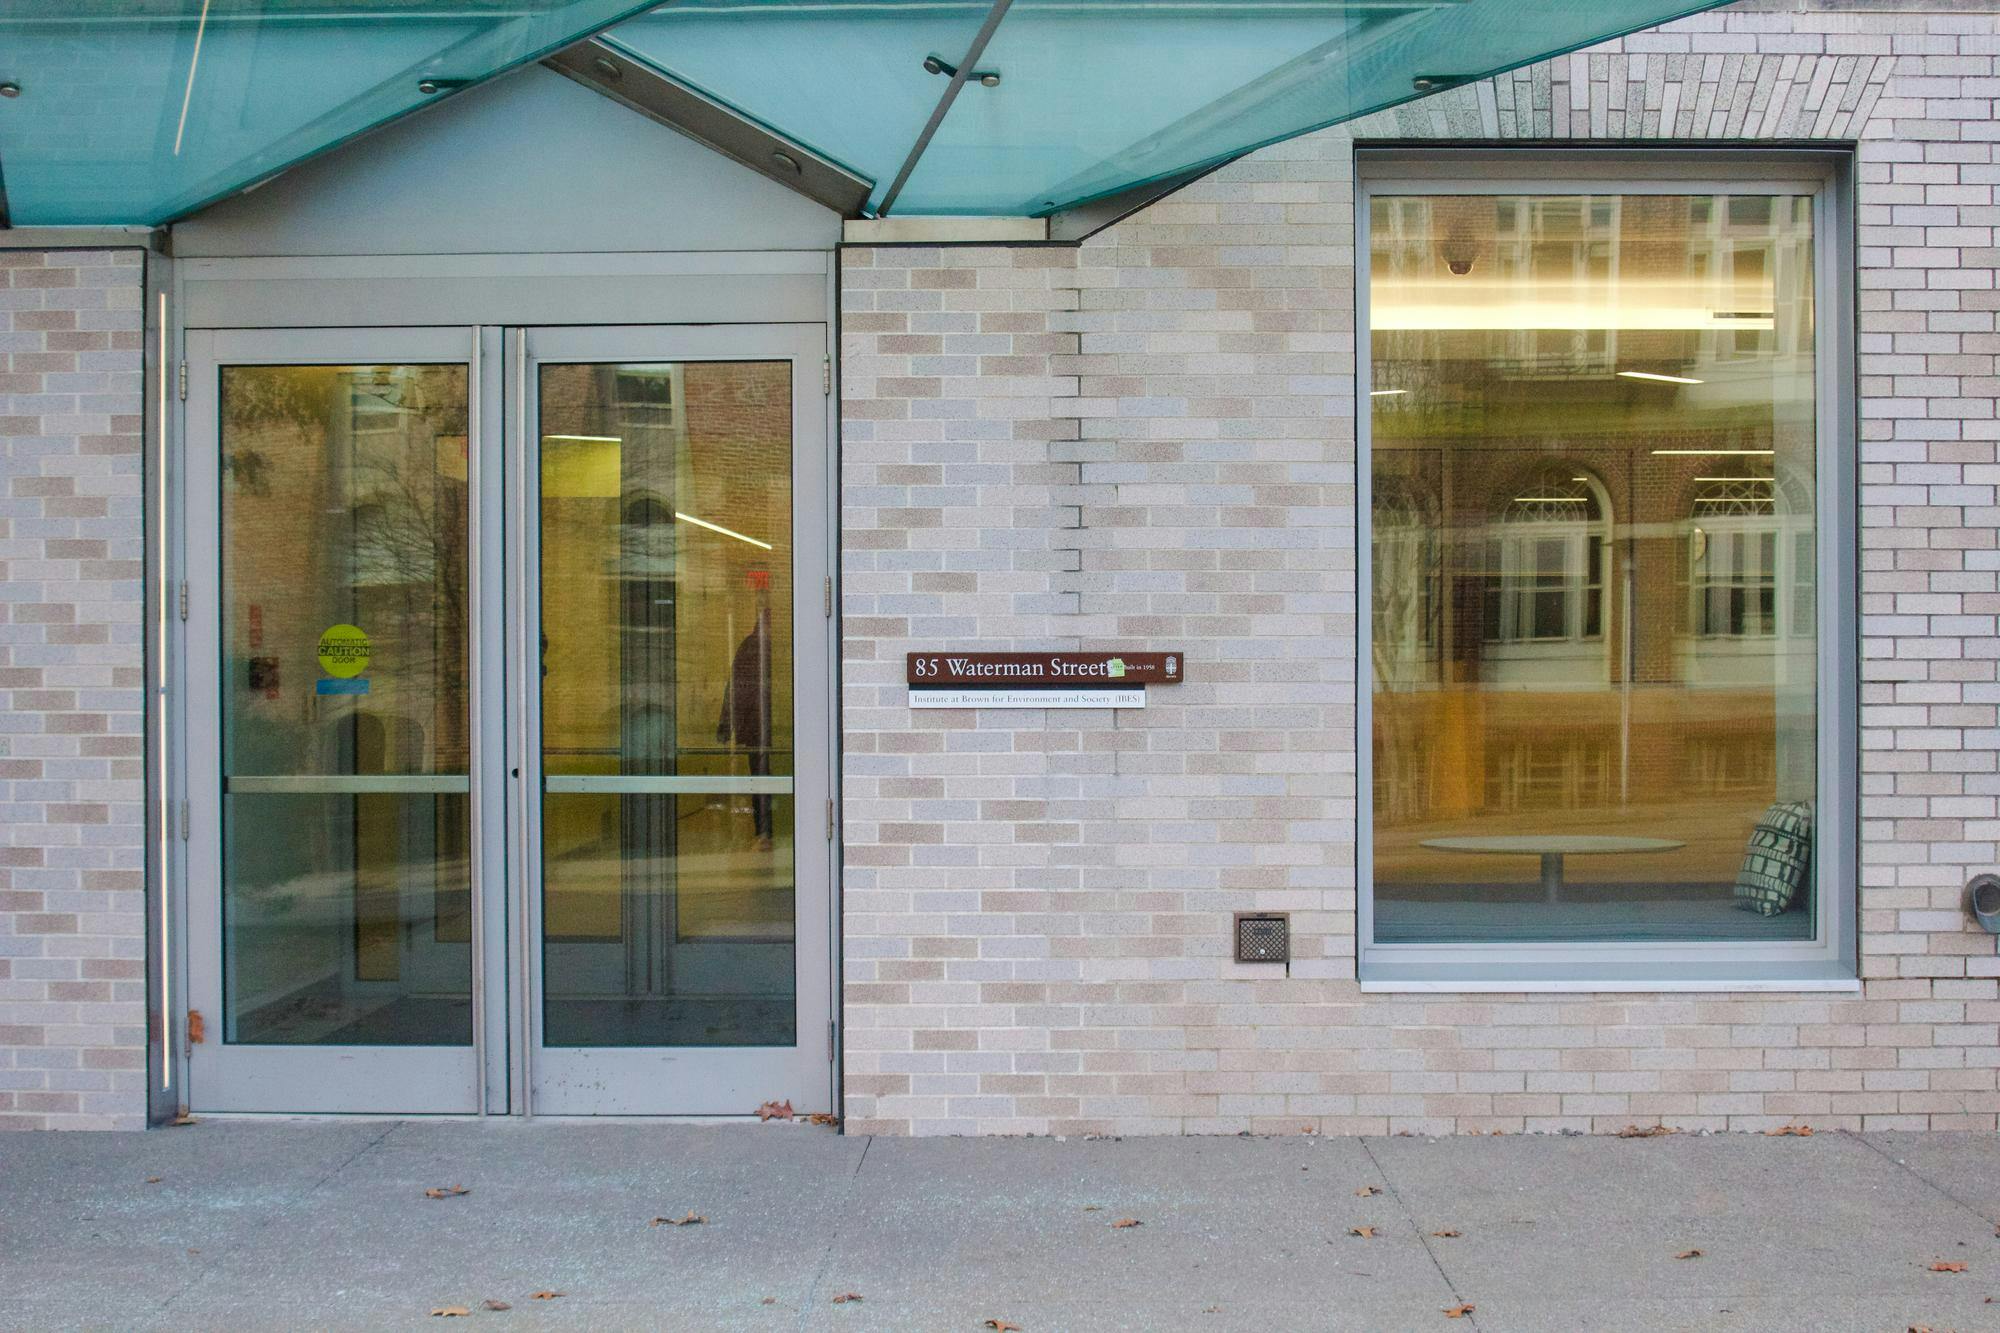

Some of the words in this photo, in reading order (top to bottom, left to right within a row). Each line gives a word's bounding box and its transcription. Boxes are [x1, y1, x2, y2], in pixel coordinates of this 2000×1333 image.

[321, 638, 368, 646] AUTOMATIC
[318, 646, 370, 656] CAUTION
[332, 656, 357, 664] DOOR
[915, 658, 939, 676] 85
[946, 658, 1044, 676] Waterman
[1050, 658, 1106, 676] Street
[914, 695, 949, 703] Institute
[962, 695, 990, 703] Brown
[992, 694, 1004, 703] for
[1007, 695, 1061, 703] Environment
[1063, 695, 1079, 703] and
[1081, 695, 1111, 705] Society
[1115, 695, 1140, 703] (IBES)
